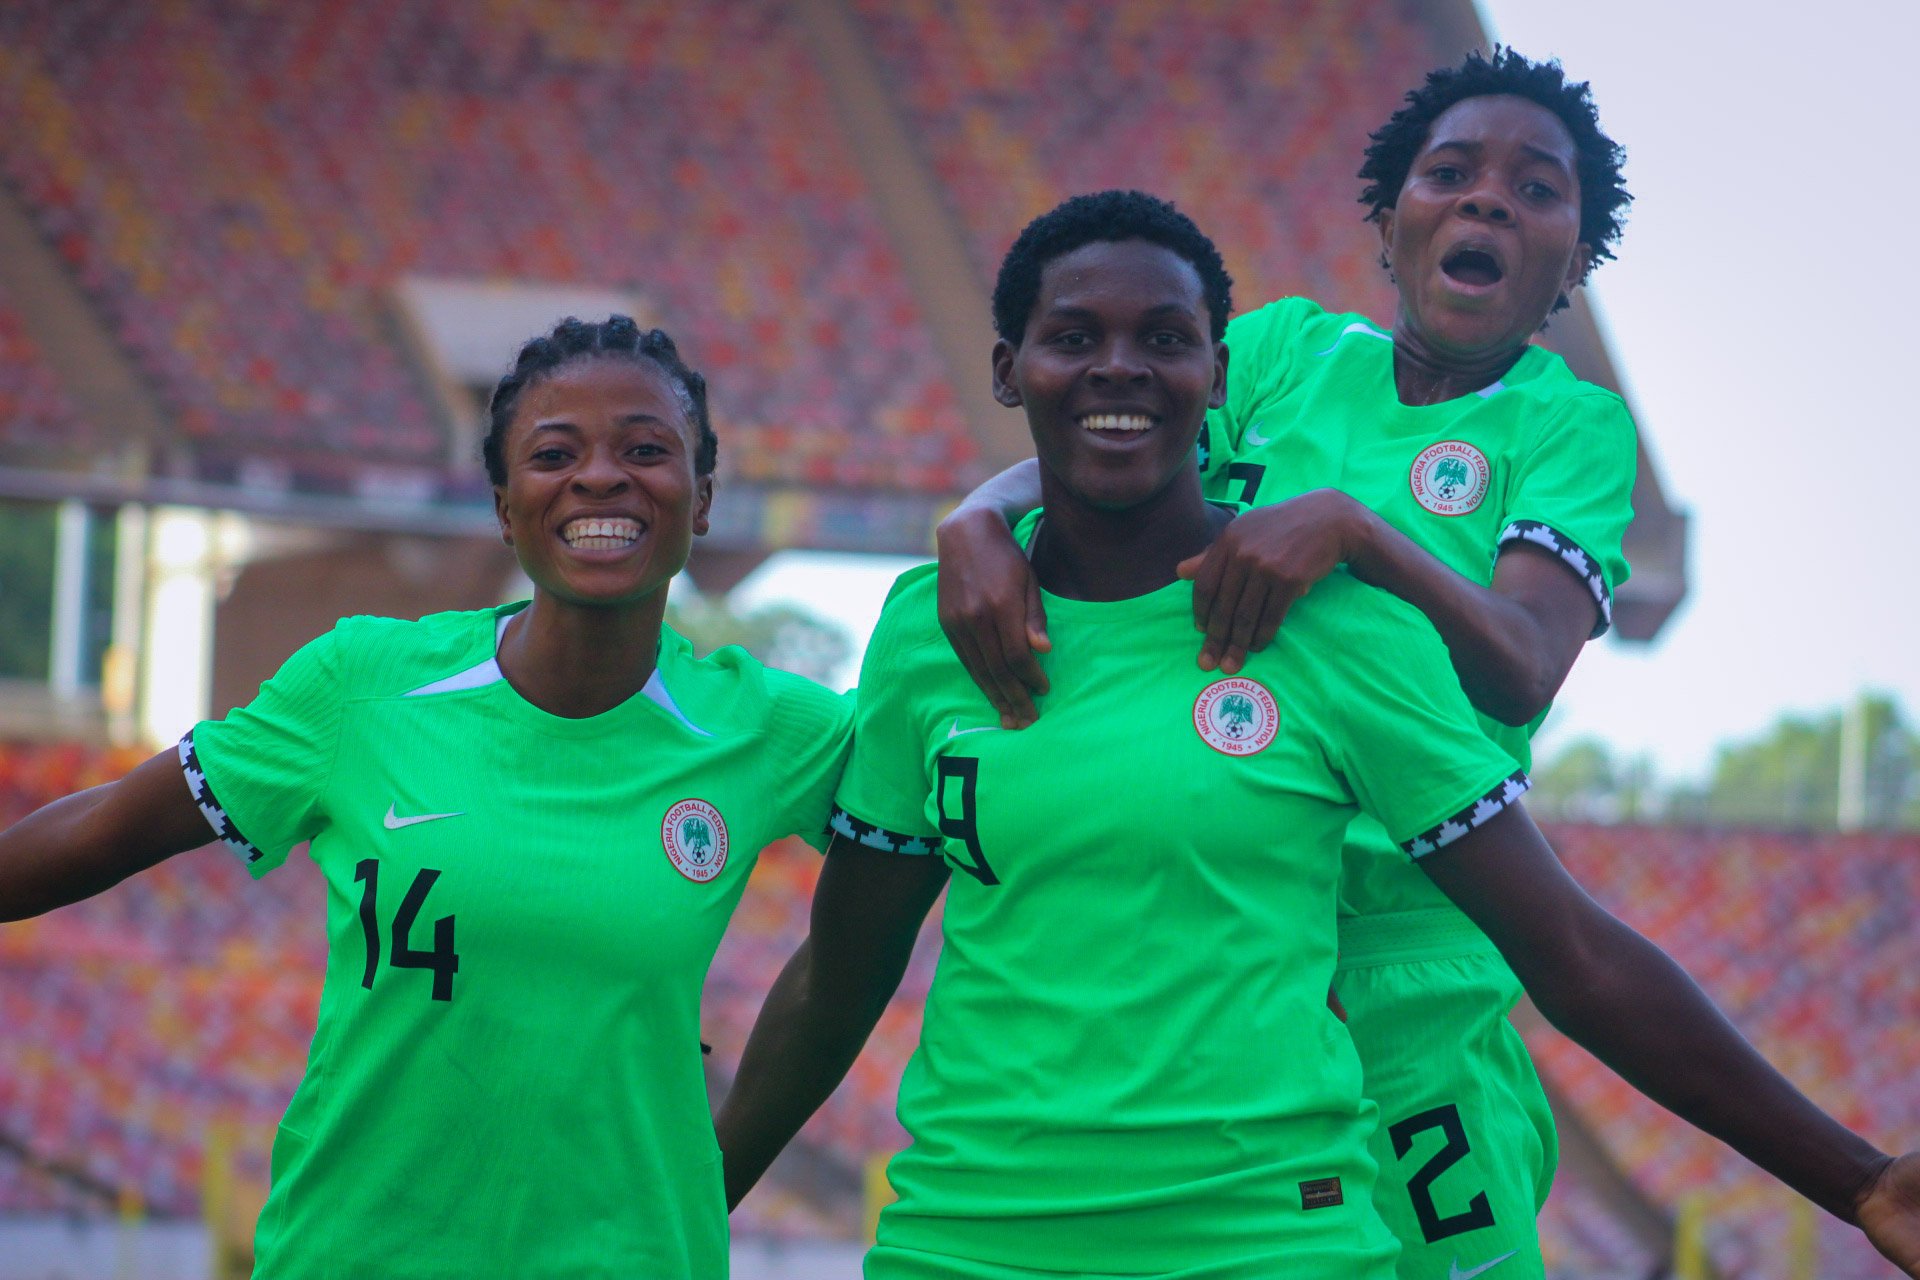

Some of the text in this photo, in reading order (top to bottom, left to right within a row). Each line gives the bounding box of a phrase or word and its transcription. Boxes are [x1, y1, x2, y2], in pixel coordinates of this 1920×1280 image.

[1414, 444, 1487, 508] NIGERIA FOOTBALL FEDERATION
[1433, 502, 1454, 511] 1945
[1198, 681, 1275, 746] NIGERIA FOOTBALL FEDERATION
[1221, 741, 1243, 751] 1945
[665, 803, 726, 868] NIGERIA FOOTBALL FEDERATION
[937, 755, 1001, 886] 9
[692, 869, 708, 878] 1945
[354, 859, 459, 1001] 14
[1388, 1103, 1495, 1244] 2
